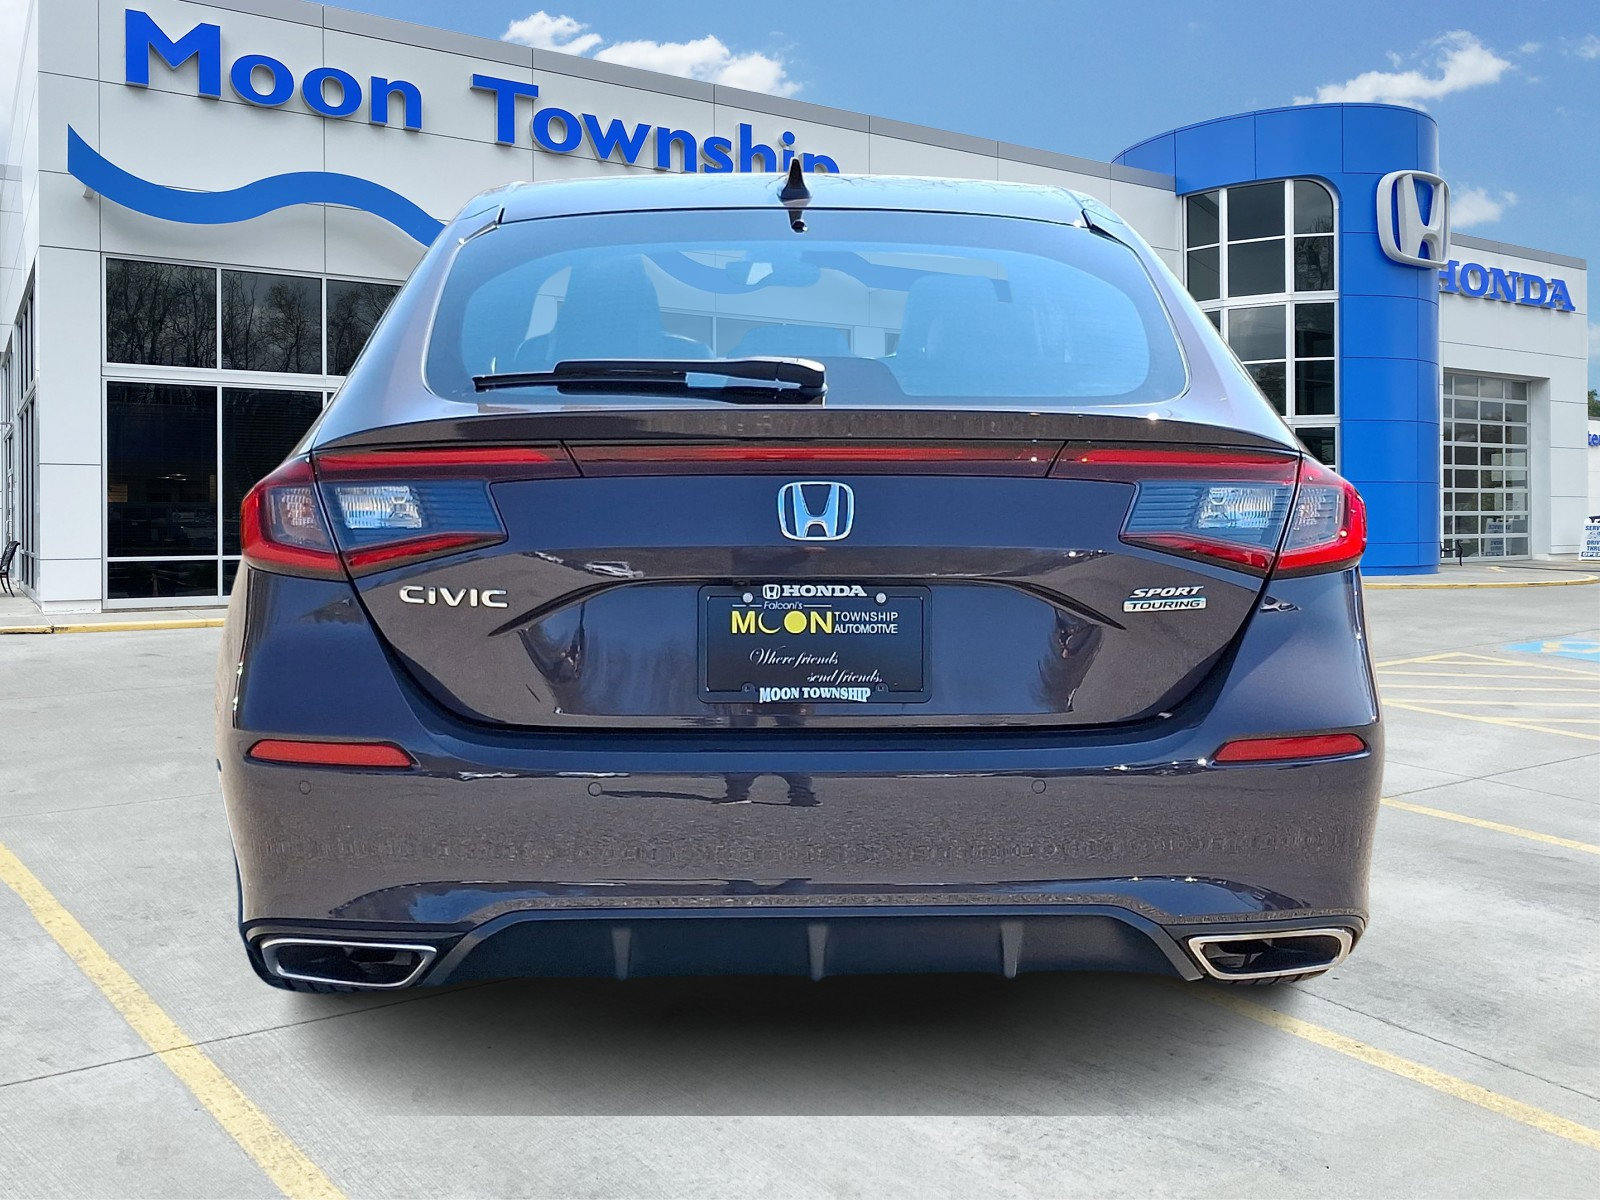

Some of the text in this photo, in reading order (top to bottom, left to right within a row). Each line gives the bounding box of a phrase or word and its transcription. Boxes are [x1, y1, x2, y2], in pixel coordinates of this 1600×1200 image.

[125, 8, 422, 132] Moon
[399, 585, 509, 608] CIVIC
[781, 584, 868, 597] HONDA
[1130, 586, 1204, 598] SPORT
[763, 601, 803, 610] Falconi's
[1130, 600, 1201, 610] TOURING
[833, 611, 899, 622] TOWNSHIP
[833, 623, 899, 634] AUTOMOTIVE
[749, 645, 839, 669] Where friends
[806, 669, 839, 683] send
[759, 687, 871, 704] MOON TOWNSHIP
